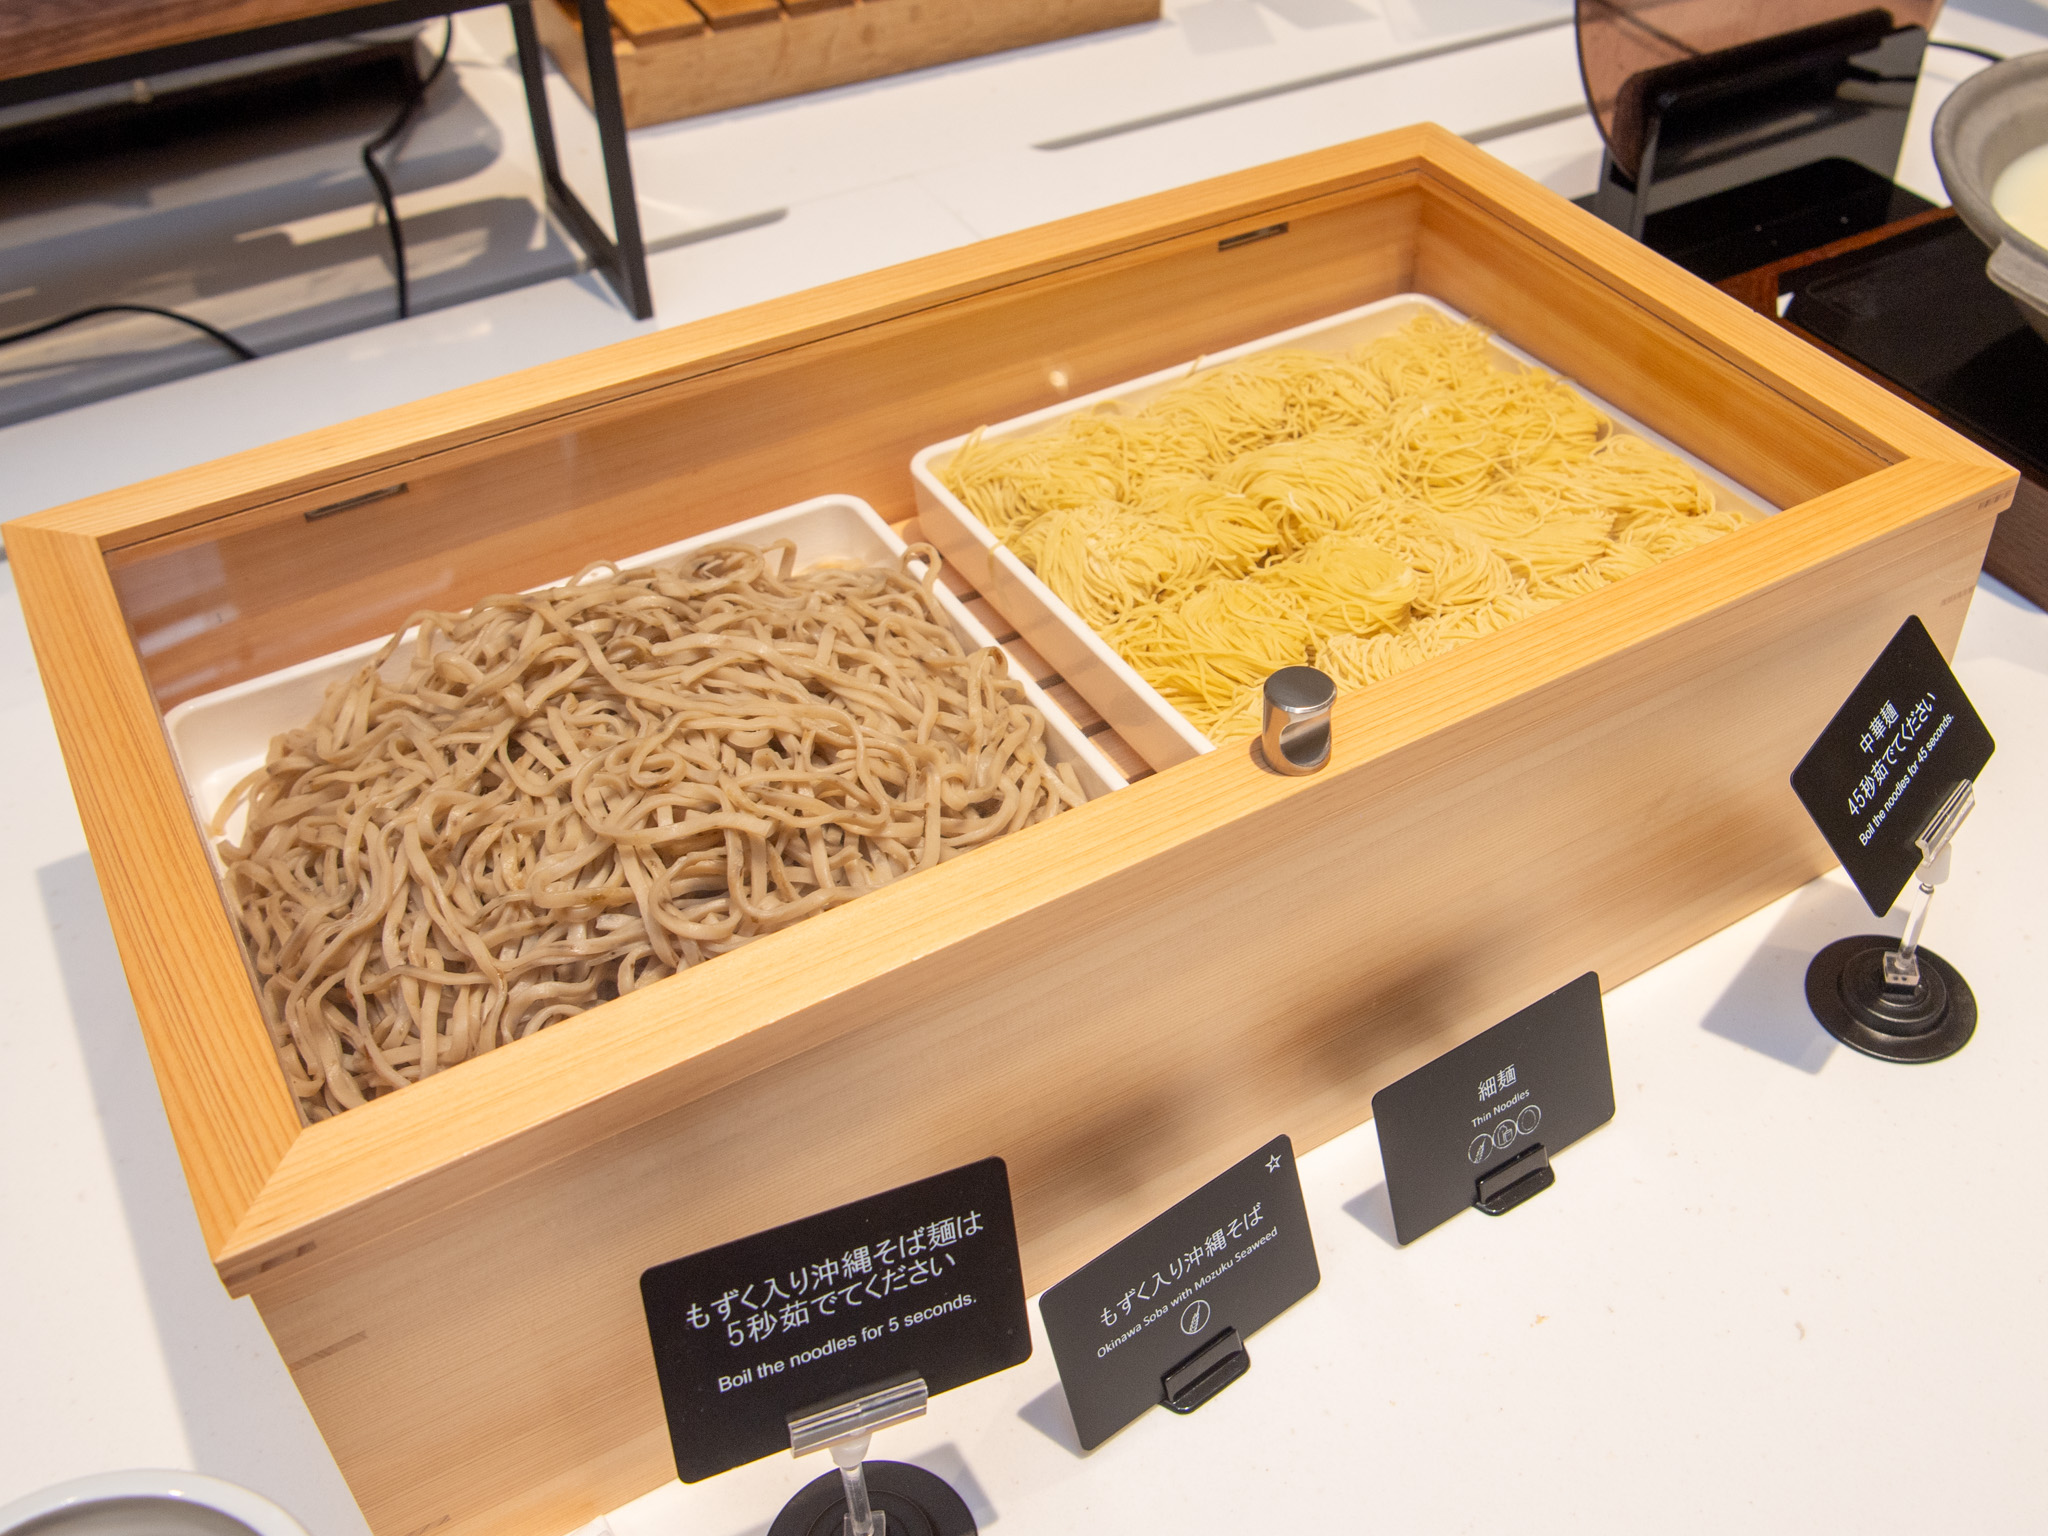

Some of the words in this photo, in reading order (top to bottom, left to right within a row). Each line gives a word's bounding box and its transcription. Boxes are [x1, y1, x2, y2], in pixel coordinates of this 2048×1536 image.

[1847, 692, 1936, 817] 45秒茹でてください
[1858, 699, 1899, 756] 中華麺
[1858, 822, 1876, 847] Boil
[1872, 808, 1886, 828] the
[1883, 773, 1911, 811] noodles
[1907, 761, 1920, 777] for
[1917, 747, 1929, 764] 45
[1926, 713, 1955, 751] seconds.
[1471, 1111, 1492, 1128] Thin
[1493, 1089, 1530, 1116] Noodles
[1477, 1063, 1517, 1101] 細麺
[686, 1210, 985, 1331] もずく入り沖縄そば麺は
[727, 1252, 956, 1347] 5秒茹でてください
[1096, 1322, 1142, 1358] Okinawa
[1143, 1303, 1169, 1327] Soba
[1170, 1287, 1193, 1308] with
[1194, 1260, 1234, 1291] Mozuku
[1234, 1226, 1278, 1262] Seaweed
[1100, 1202, 1264, 1327] もずく入り沖縄そば
[718, 1368, 753, 1394] Boil
[757, 1357, 785, 1378] the
[789, 1334, 857, 1368] noodles
[861, 1323, 885, 1343] for
[889, 1317, 900, 1332] 5
[903, 1294, 978, 1328] seconds.
